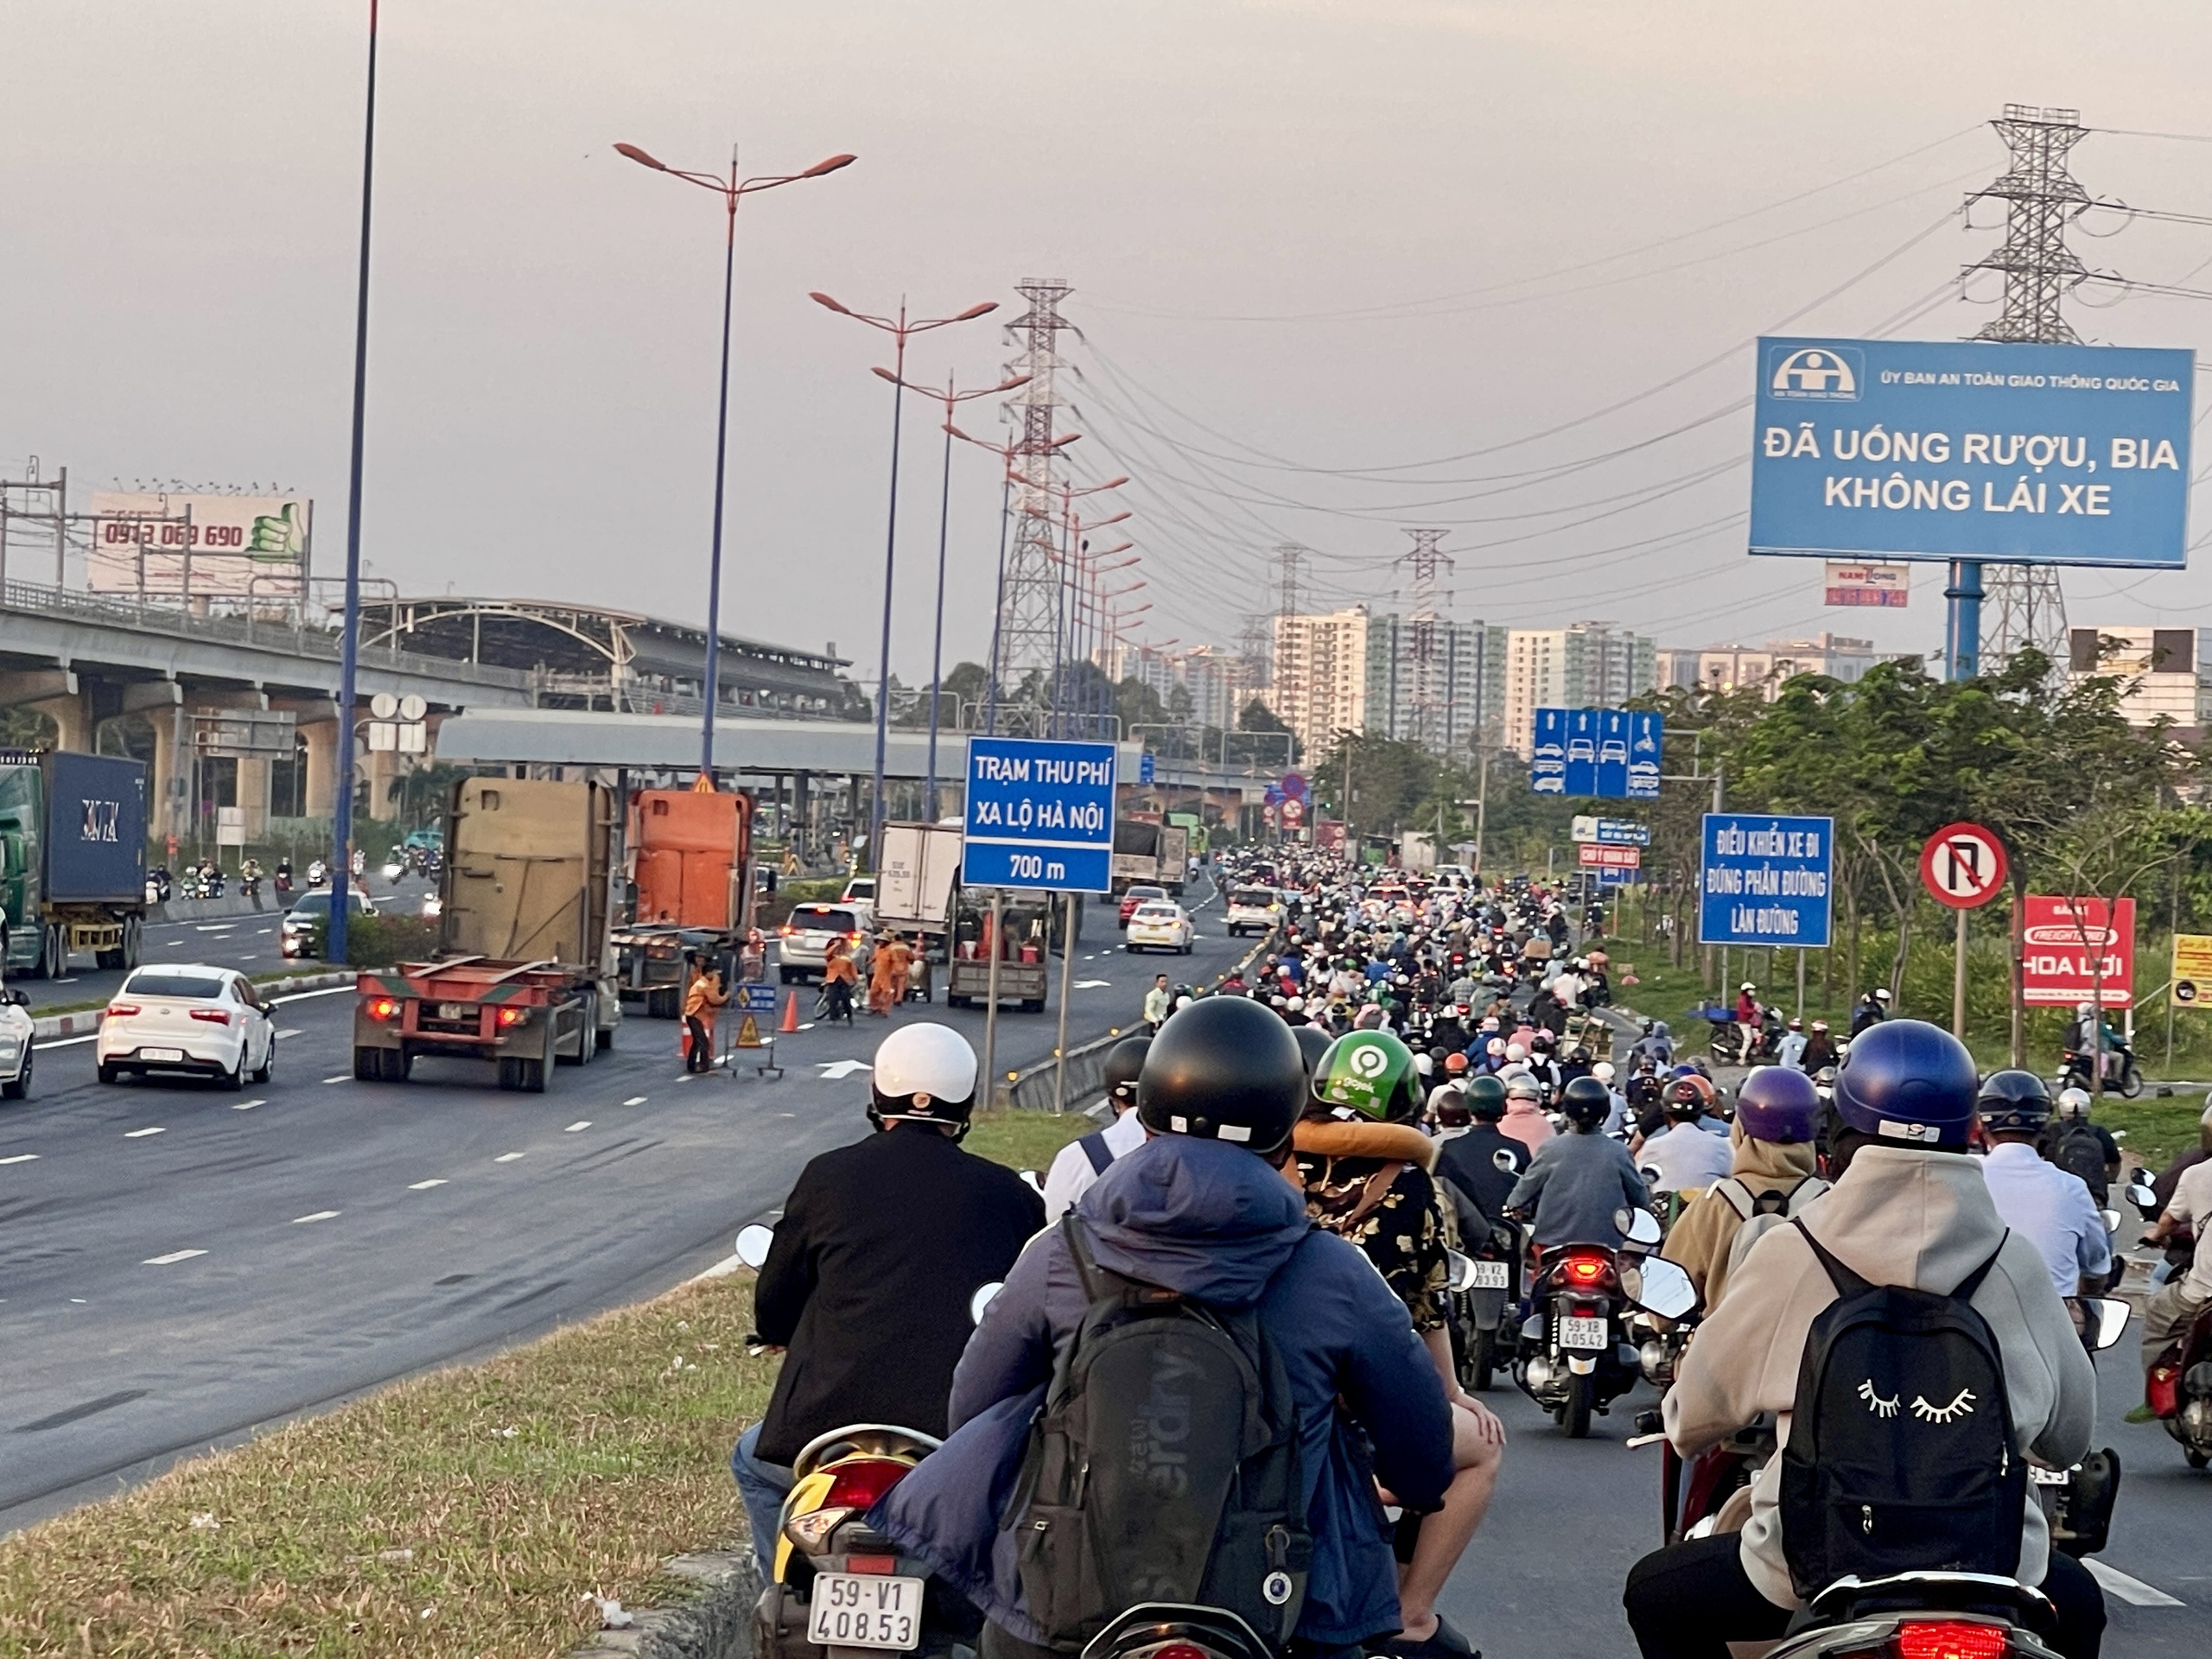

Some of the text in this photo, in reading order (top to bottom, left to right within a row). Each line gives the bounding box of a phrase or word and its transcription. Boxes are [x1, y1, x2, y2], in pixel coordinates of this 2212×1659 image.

[1904, 372, 1936, 385] BAN
[1938, 373, 1961, 385] AN
[1963, 372, 2005, 386] TOÀN
[2007, 375, 2045, 388] GIAO
[2050, 374, 2101, 389] THÔNG
[2152, 379, 2180, 391] GIA
[1764, 422, 1821, 459] ĐÃ
[1962, 434, 2096, 474] RƯỢU,
[2111, 438, 2179, 471] BIA
[1825, 472, 2111, 516] KHÔNG LÁI XE
[205, 525, 243, 546] 690
[976, 755, 1113, 786] TRẠM THU PHÍ
[976, 798, 1104, 836] XA LỘ HÀ NỘI
[1747, 822, 1785, 856] KHIỂN
[1787, 831, 1805, 857] XE
[1806, 832, 1820, 858] ĐI
[1010, 855, 1065, 880] 700 m
[1707, 863, 1742, 894] ĐÚNG
[1782, 864, 1827, 897] ĐƯỜNG
[1732, 903, 1800, 935] LÀN ĐƯỜNG
[2023, 956, 2075, 976] HOA
[830, 1579, 902, 1611] 59-V1
[817, 1610, 912, 1643] 408.53
